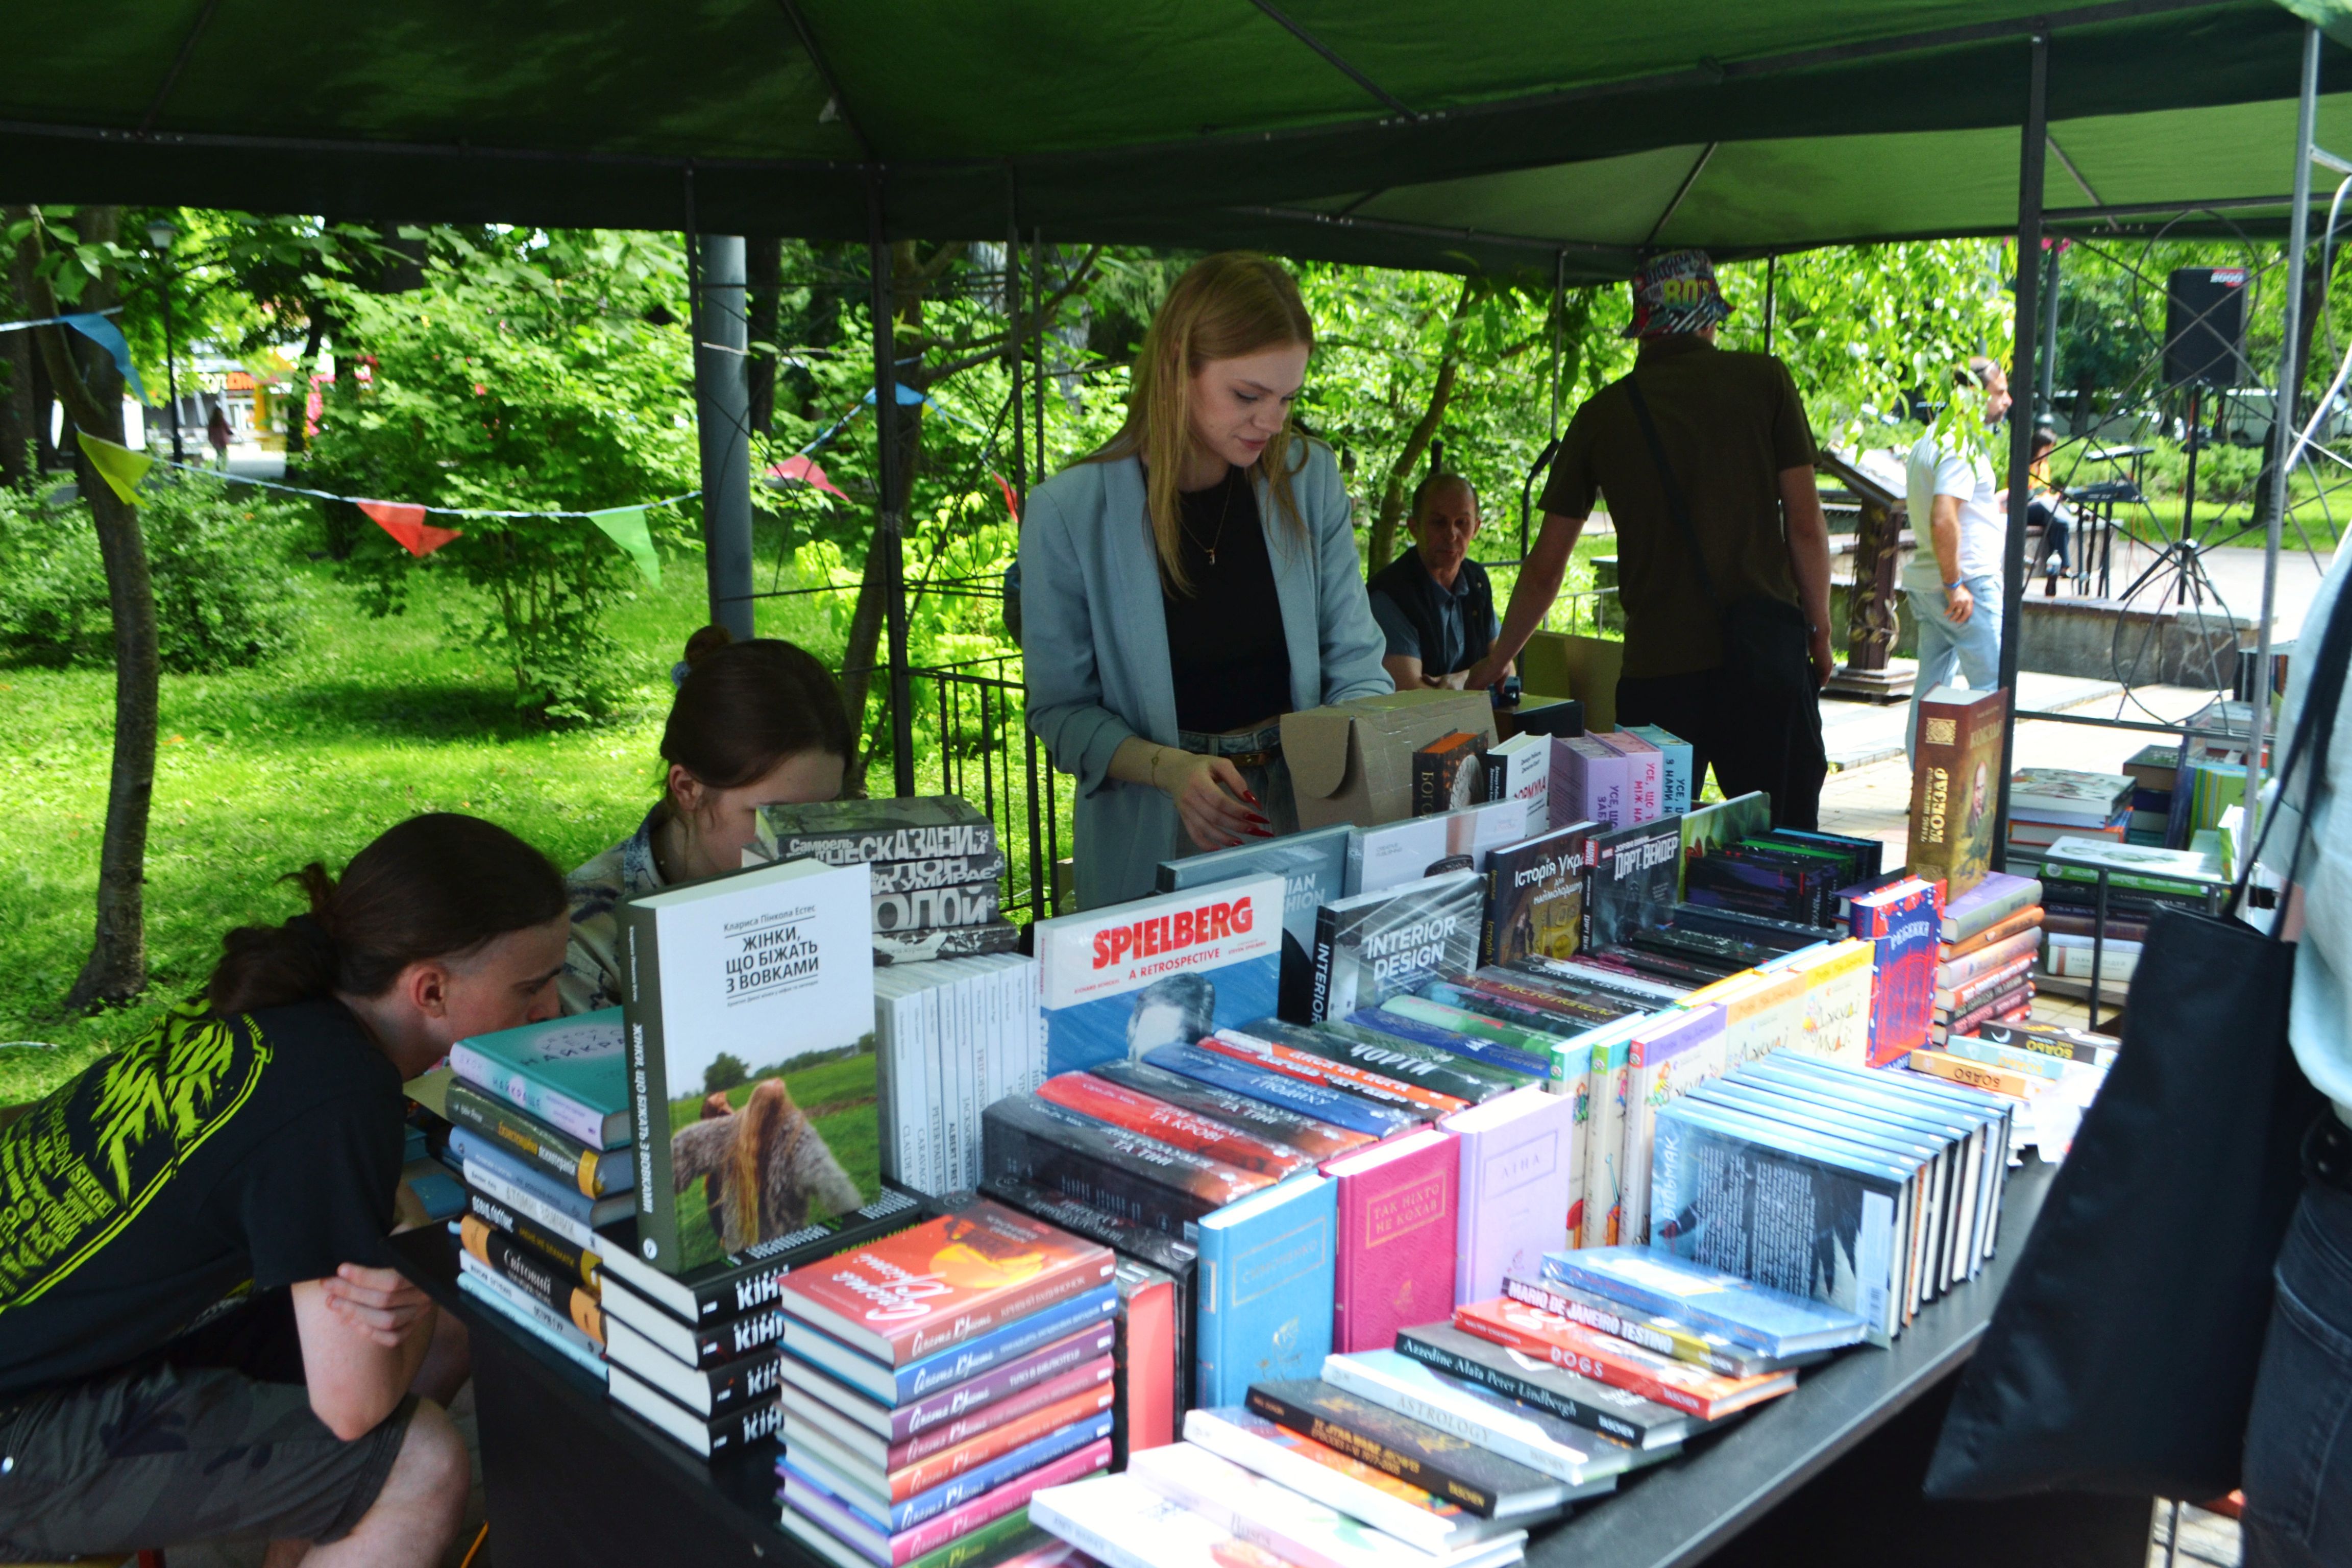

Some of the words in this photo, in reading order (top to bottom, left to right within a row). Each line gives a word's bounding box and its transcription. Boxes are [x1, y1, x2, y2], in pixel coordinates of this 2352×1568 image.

[1633, 780, 1644, 803] МІЖ
[1643, 763, 1656, 786] УСЕ,
[1607, 785, 1621, 808] УСЕ,
[1931, 767, 1949, 843] КОБЗАР
[790, 839, 854, 854] Самюель
[1614, 847, 1641, 881] ДАРТ
[1643, 836, 1680, 871] ВЕЙДЕР
[1514, 857, 1556, 888] Історія
[724, 918, 759, 933] Клариса
[761, 910, 793, 923] Пінкола
[795, 905, 816, 916] Естес
[1092, 896, 1254, 970] SPIELBERG
[743, 926, 801, 952] ЖІНКИ,
[1367, 916, 1456, 960] INTERIOR
[726, 955, 754, 975] ЩО
[759, 940, 818, 966] БІЖАТЬ
[726, 977, 735, 994] З
[740, 957, 819, 990] ВОВКАМИ
[1129, 969, 1137, 981] A
[1140, 948, 1220, 977] RETROSPECTIVE
[1374, 941, 1444, 979] DESIGN
[1310, 943, 1330, 1022] INTERIOR
[632, 1023, 644, 1068] ЖІНКИ,
[1351, 1043, 1440, 1076] ЧОРТИ
[634, 1069, 647, 1092] ЩО
[636, 1095, 649, 1140] БІЖАТЬ
[931, 1106, 941, 1142] PETER
[961, 1097, 973, 1146] JACKSON
[1149, 1111, 1169, 1123] ТА
[1171, 1121, 1224, 1142] КРОВІ
[901, 1125, 912, 1173] CLAUDE
[933, 1144, 942, 1173] PAUL
[947, 1122, 957, 1159] ALBERT
[1113, 1140, 1134, 1153] ТА
[1138, 1148, 1174, 1166] ТІНІ
[916, 1128, 928, 1194] CARAVAGG
[949, 1163, 958, 1188] FREY
[964, 1148, 975, 1193] POLLOC
[71, 1165, 111, 1215] SIEGE
[640, 1151, 653, 1213] ВОВКАМИ
[1374, 1202, 1399, 1219] ТАК
[1402, 1184, 1440, 1211] НІХТО
[1376, 1217, 1393, 1234] НЕ
[1396, 1199, 1438, 1227] КОХАВ
[736, 1270, 779, 1311] КІН
[733, 1310, 784, 1353] КІН
[1508, 1280, 1548, 1308] MARIO
[1549, 1294, 1566, 1314] DE
[1566, 1301, 1620, 1335] JANEIRO
[1620, 1319, 1674, 1355] TESTINO
[1402, 1338, 1453, 1369] Azzedine
[1455, 1353, 1486, 1382] Alaïa
[1487, 1365, 1516, 1395] Peter
[1518, 1380, 1577, 1419] Lindbergh
[1550, 1346, 1604, 1378] DOGS
[743, 1404, 784, 1444] КІН
[1398, 1395, 1490, 1444] ASTROLOGY
